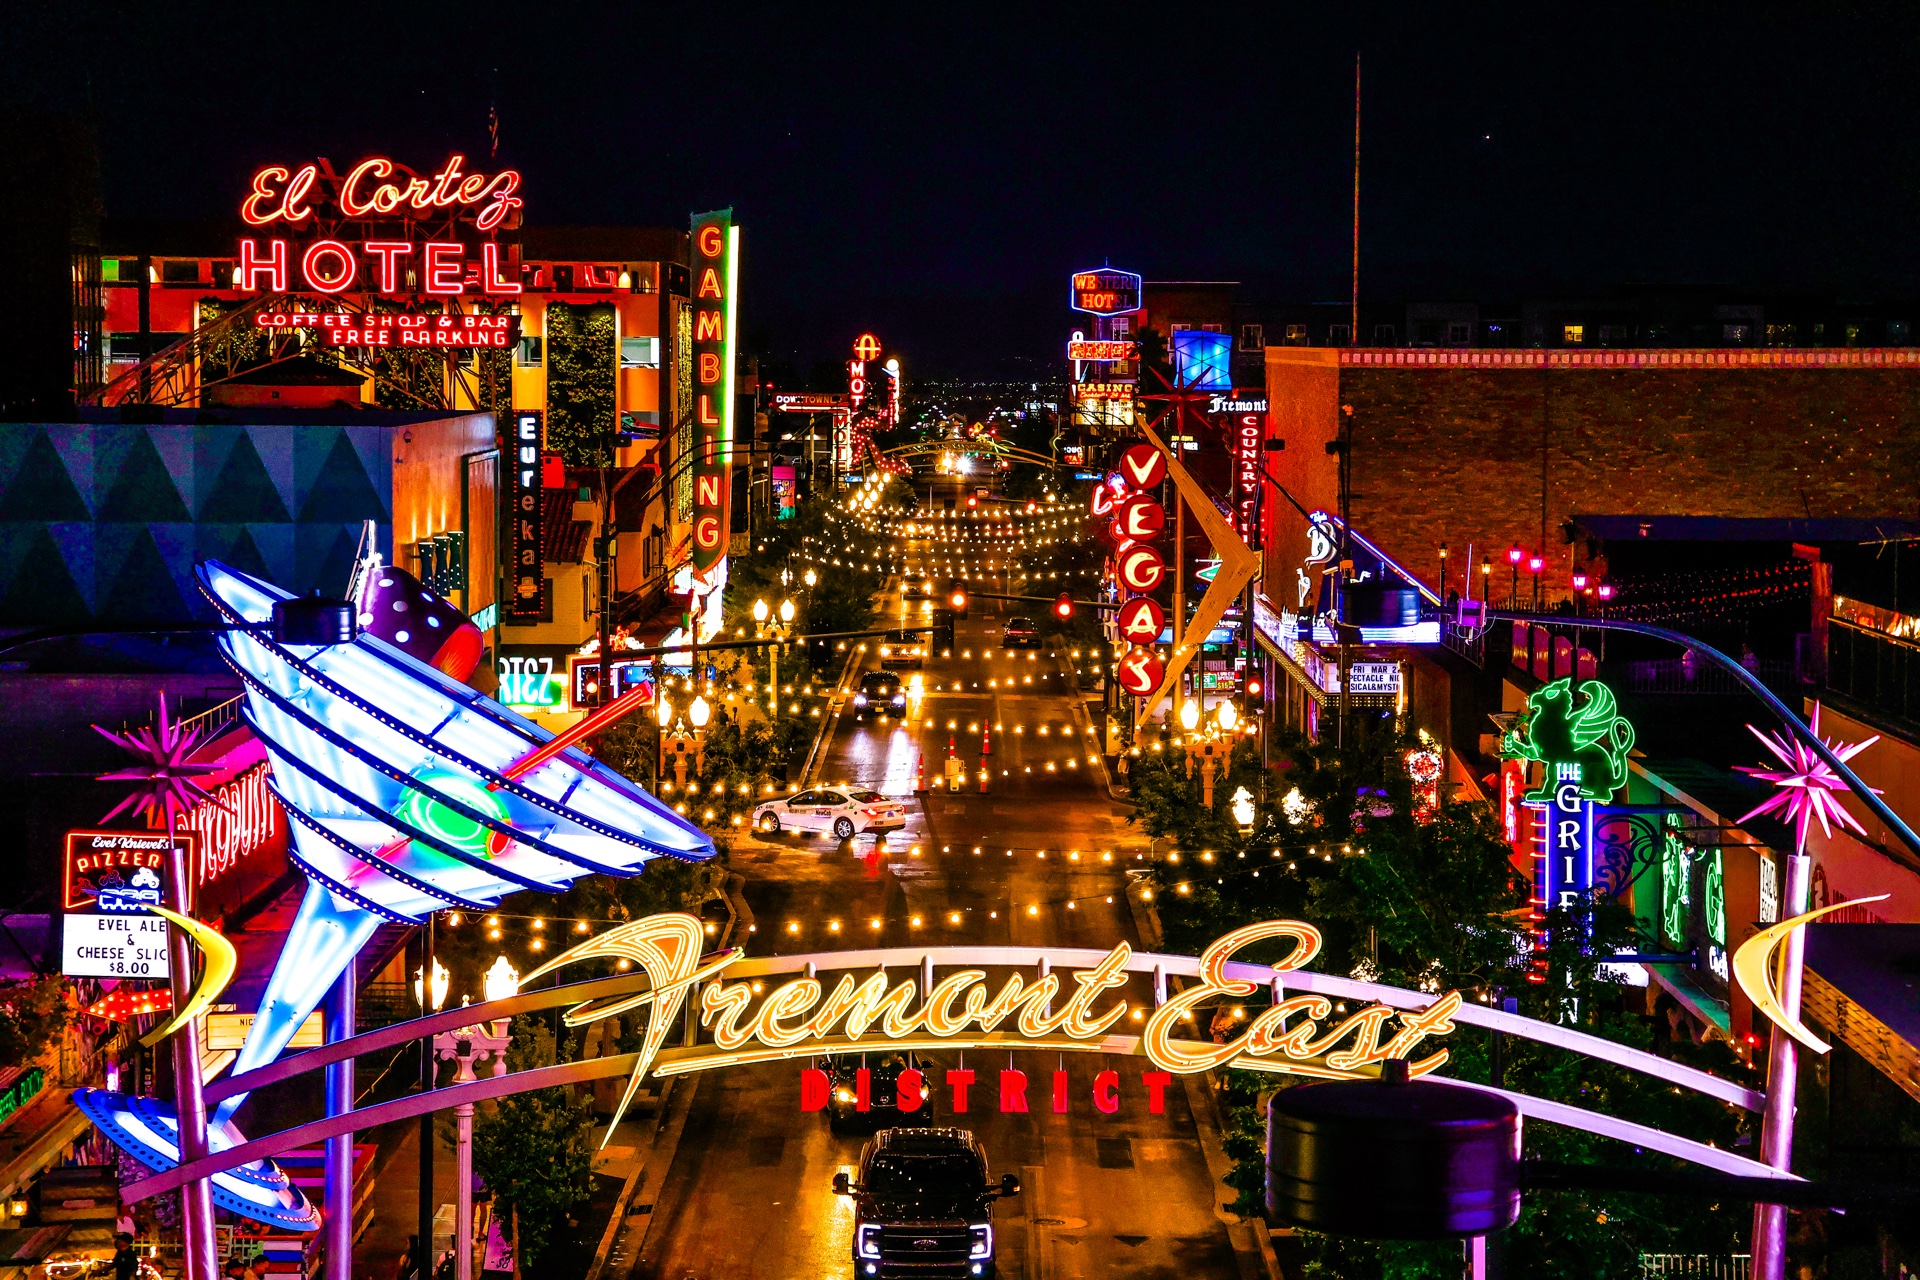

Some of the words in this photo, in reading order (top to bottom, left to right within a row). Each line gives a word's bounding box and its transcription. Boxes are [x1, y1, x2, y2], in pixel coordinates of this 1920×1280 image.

[241, 165, 316, 224] El
[340, 155, 523, 230] Cortez
[241, 240, 523, 293] HOTEL
[1075, 275, 1138, 289] WESTERN
[1082, 294, 1132, 308] HOTEL
[257, 315, 350, 326] COFFEE
[365, 315, 426, 327] SHOP
[438, 316, 452, 326] &
[465, 316, 508, 327] BAR
[333, 329, 389, 344] FREE
[403, 329, 506, 345] PARKING
[696, 226, 724, 547] GAMBLING
[1077, 384, 1133, 392] CASINO
[1207, 394, 1267, 413] Fremont
[1242, 416, 1258, 492] COUNTRY
[521, 417, 536, 566] Eureka
[1123, 450, 1165, 693] VEGAS
[1556, 763, 1581, 781] THE
[92, 836, 117, 848] Evel
[117, 837, 170, 849] Knievel's
[98, 919, 131, 931] EVEL
[140, 920, 166, 932] ALE
[127, 934, 135, 946] &
[77, 946, 125, 959] CHEESE
[110, 962, 150, 974] $8.00
[517, 912, 1131, 1150] Fremont
[1144, 920, 1462, 1080] East
[801, 1069, 1173, 1114] DISTRICT
